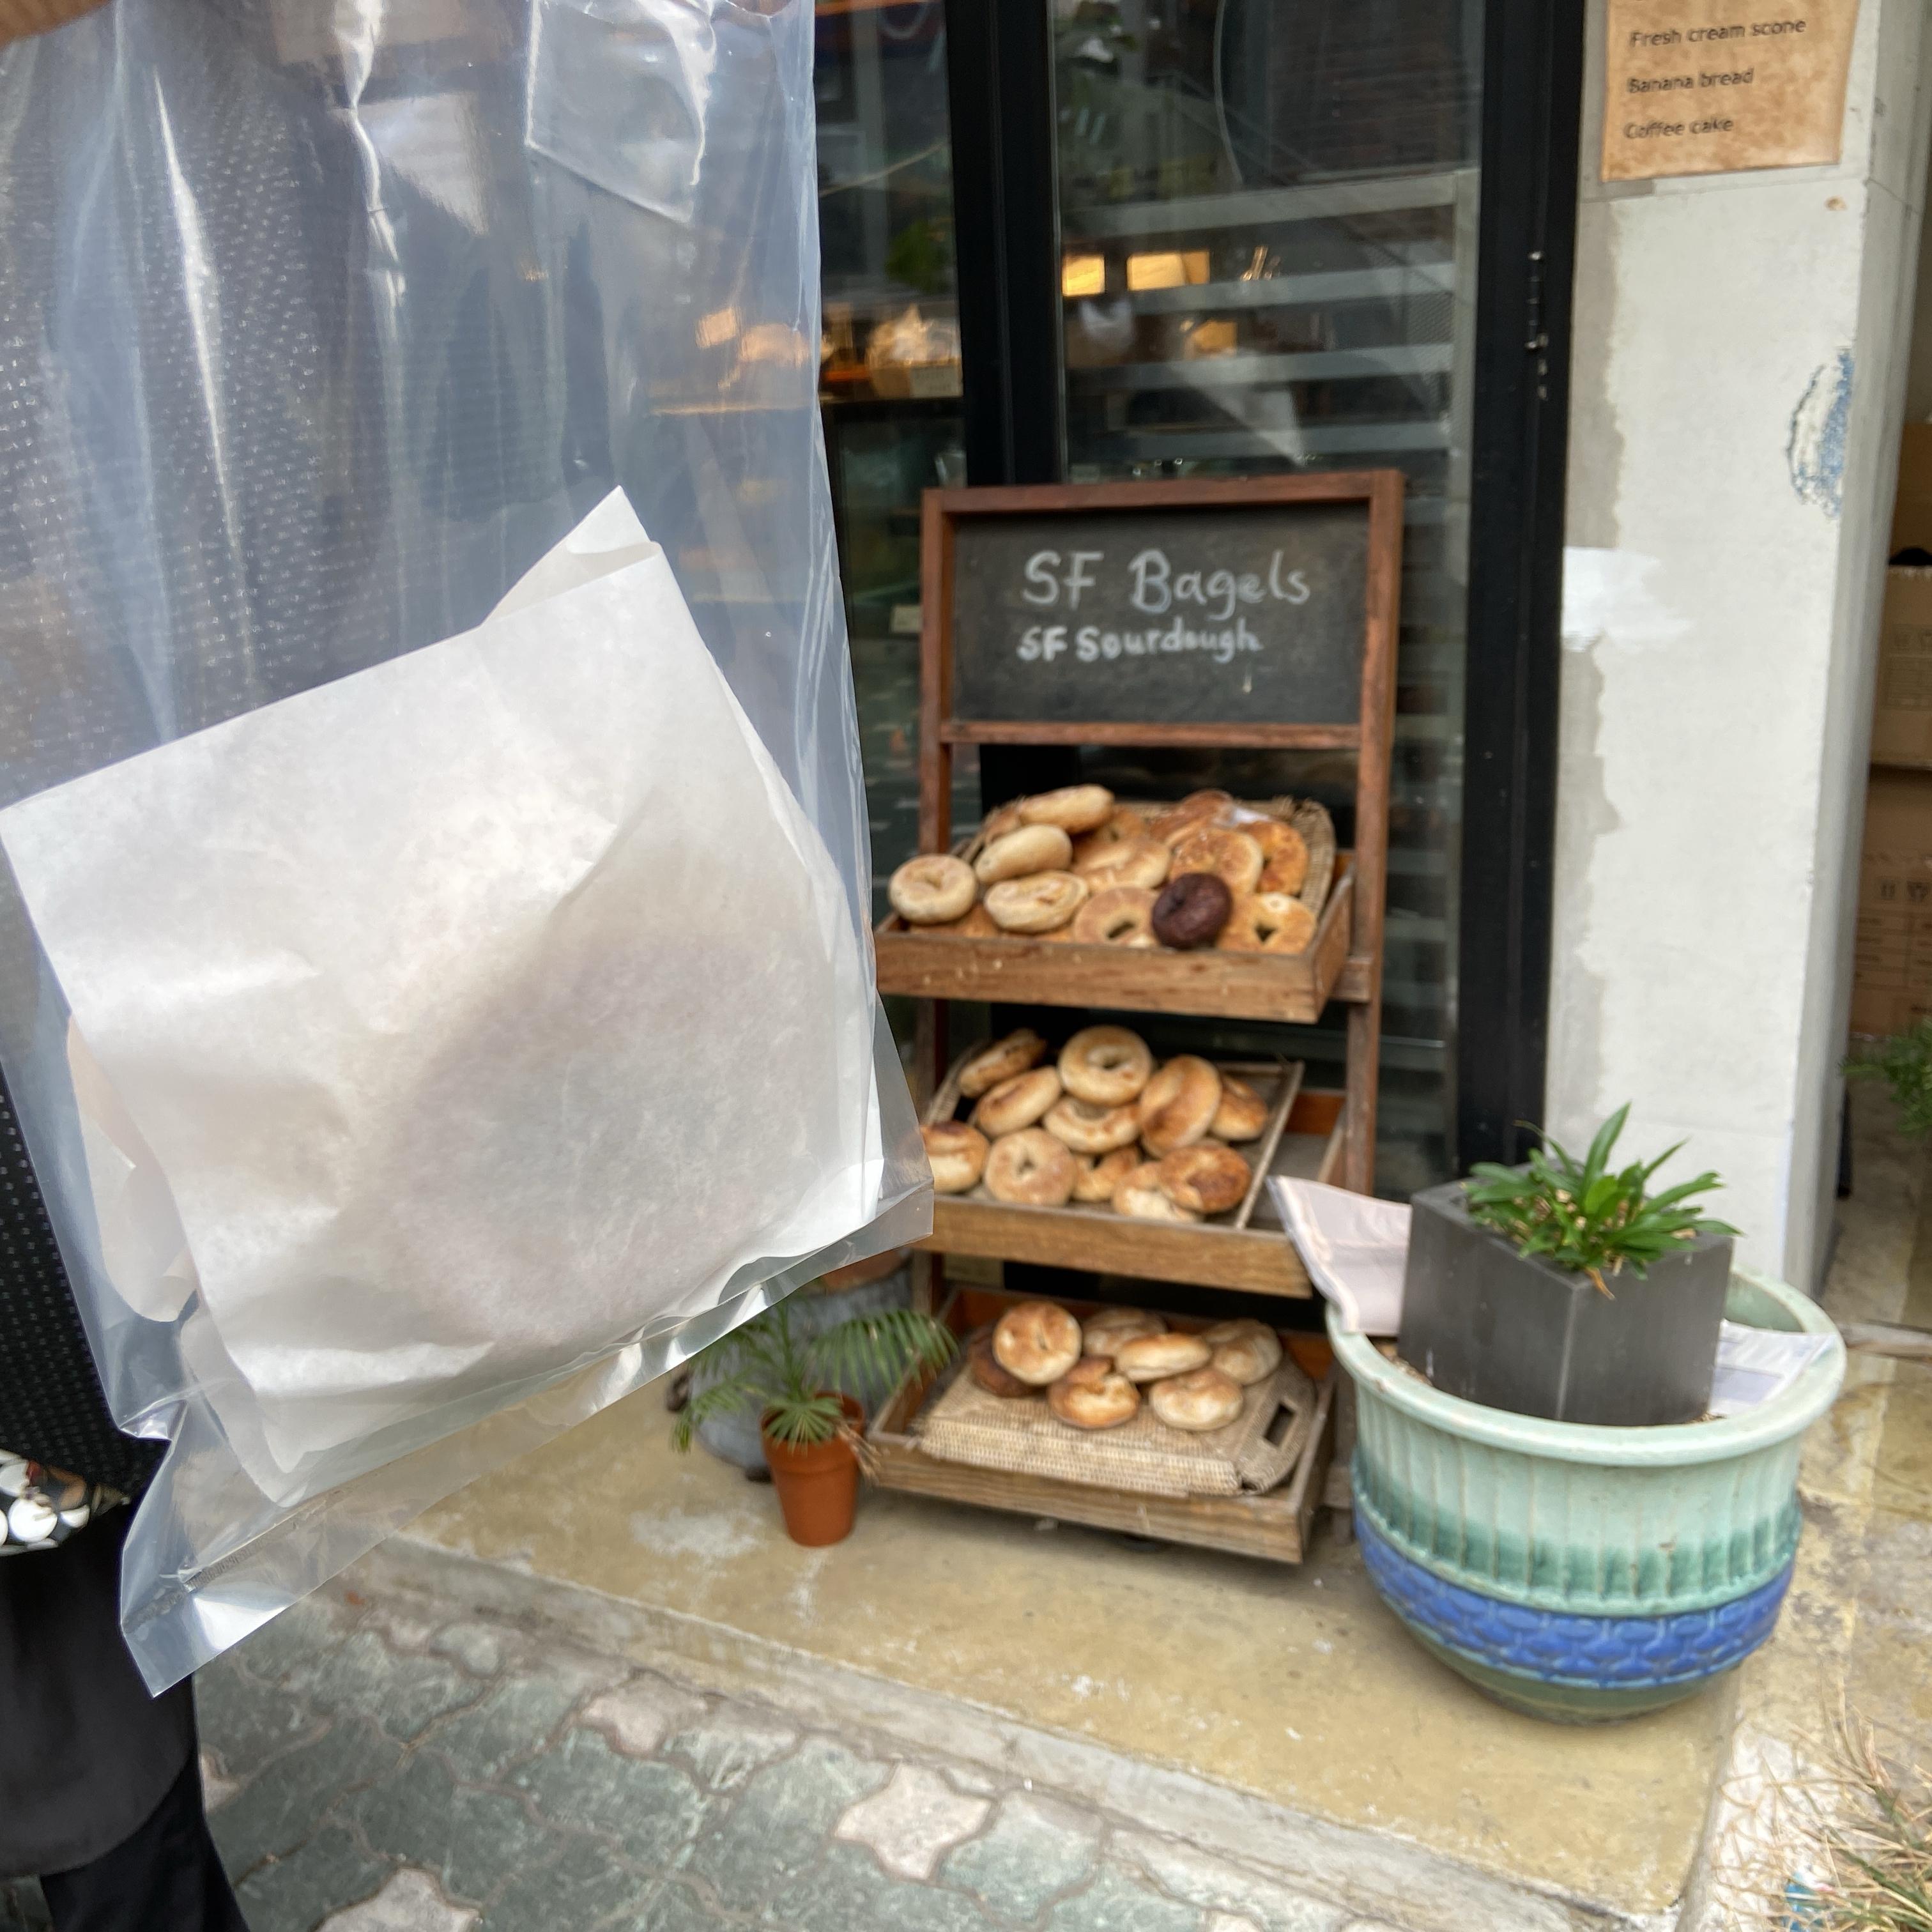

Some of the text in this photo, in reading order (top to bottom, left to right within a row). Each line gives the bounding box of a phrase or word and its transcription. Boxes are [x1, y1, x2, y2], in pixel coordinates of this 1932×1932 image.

[1630, 19, 1806, 47] Fresh cream scone
[1627, 68, 1754, 93] Banana bread
[1623, 117, 1734, 139] Coffee cake
[1022, 548, 1310, 620] SF Bagels
[1017, 617, 1264, 663] SF Sourdough
